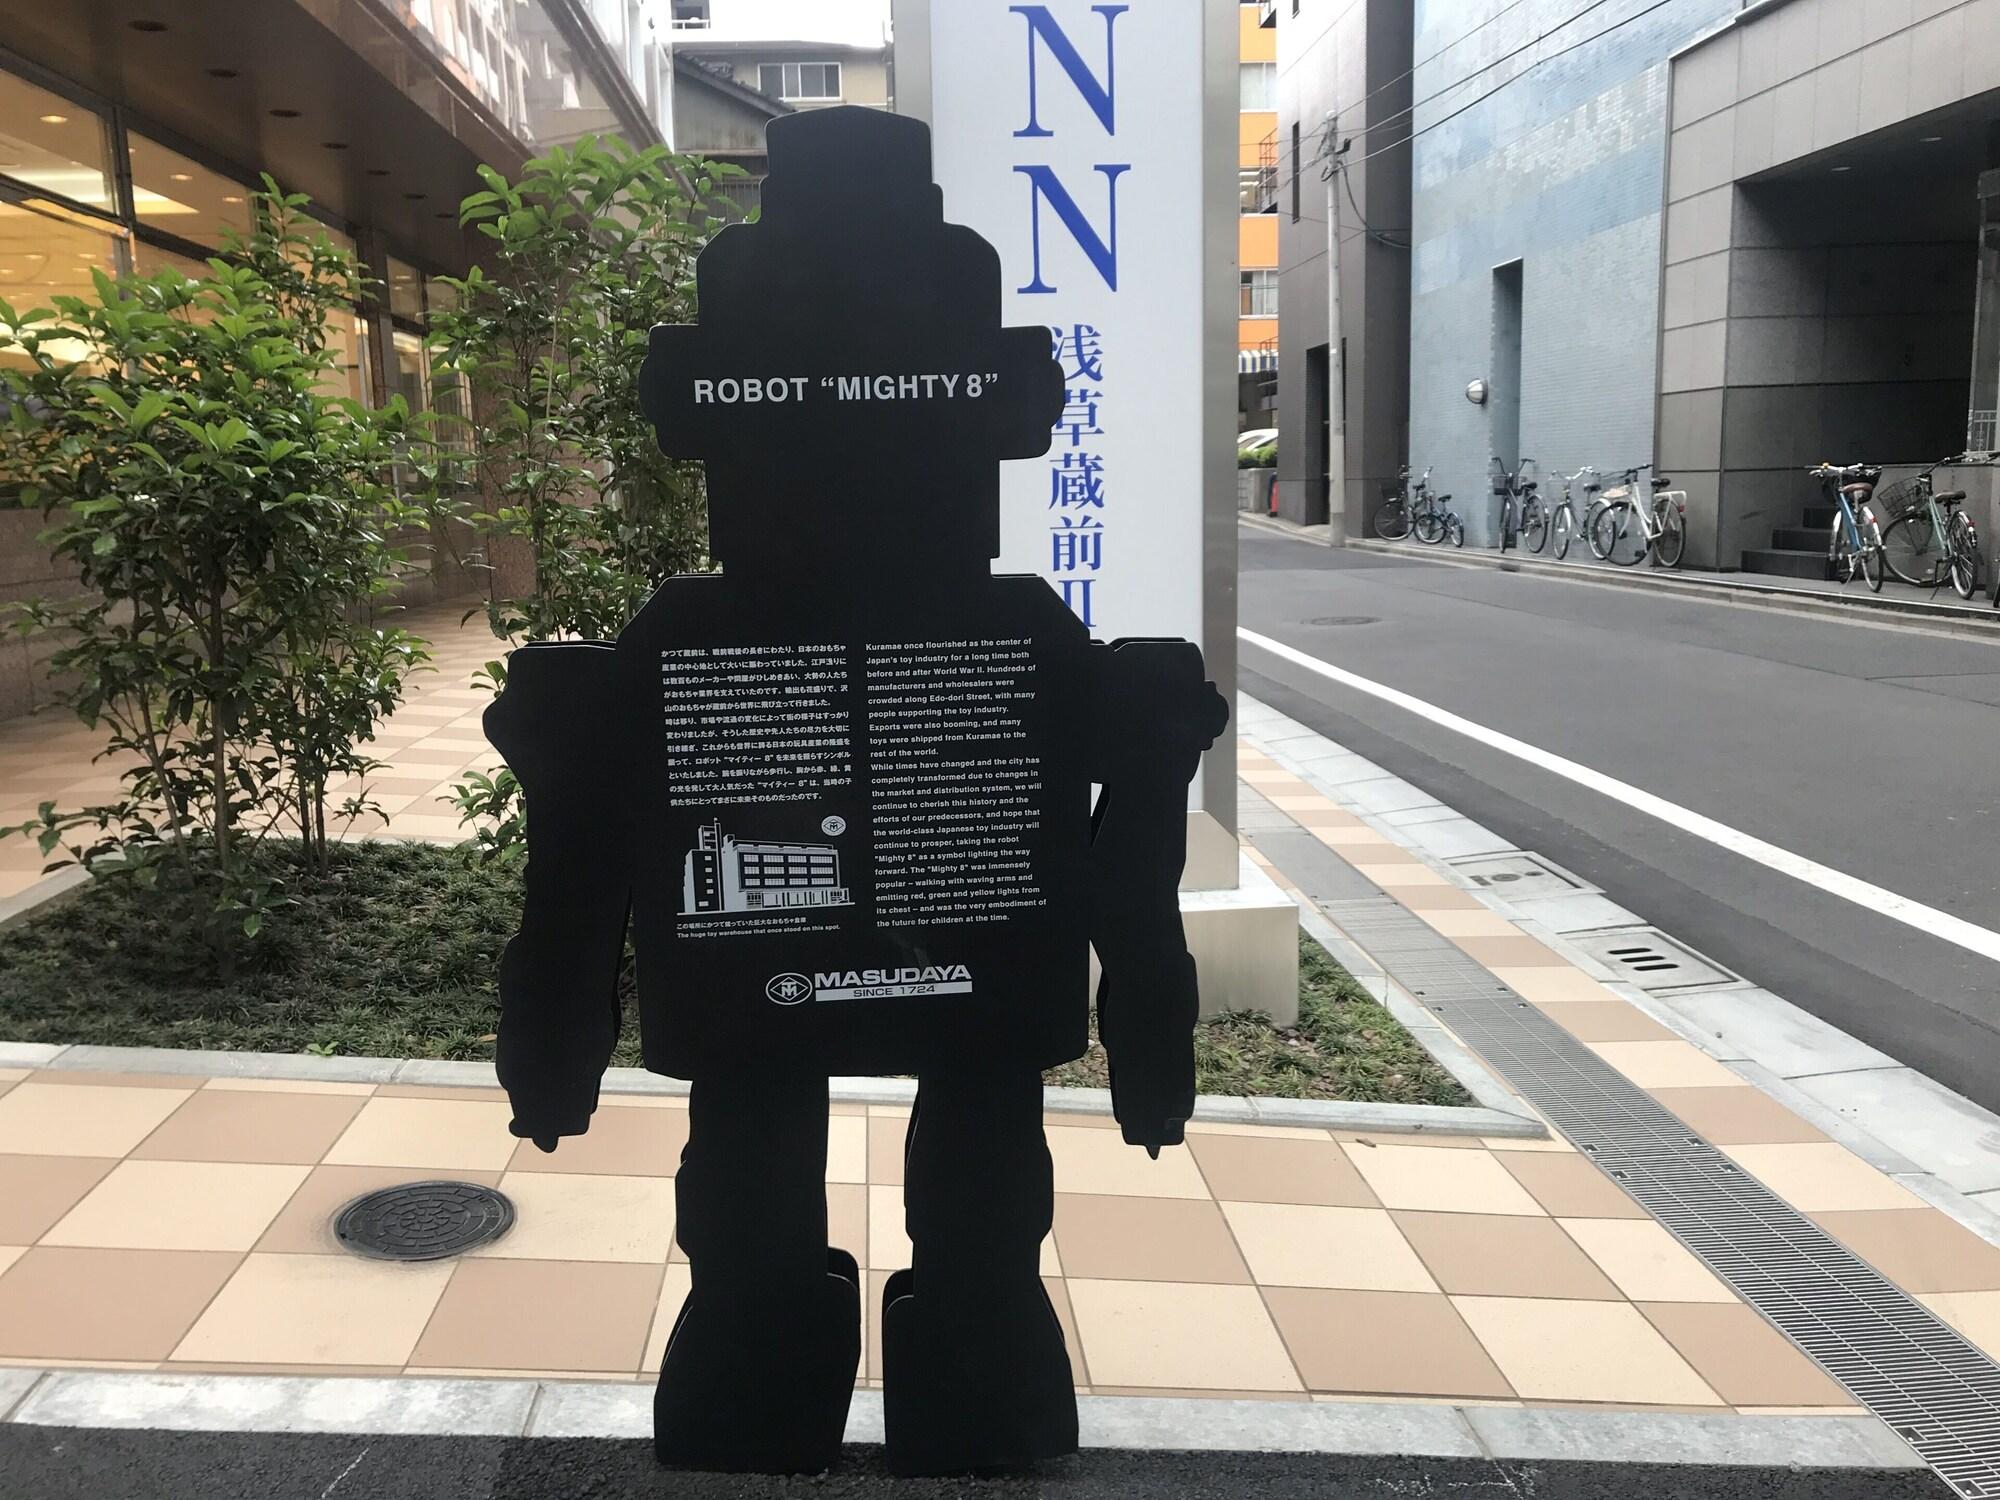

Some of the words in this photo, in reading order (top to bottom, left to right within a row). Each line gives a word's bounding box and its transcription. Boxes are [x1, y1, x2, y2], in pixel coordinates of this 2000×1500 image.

[694, 377, 809, 403] ROBOT
[821, 374, 960, 401] “MIGHTY
[925, 640, 966, 648] flourished
[866, 656, 897, 665] Japan's
[899, 656, 912, 664] toy
[971, 653, 989, 661] long
[986, 664, 1025, 672] Hundreds
[867, 696, 902, 704] crowded
[904, 695, 927, 703] along
[929, 693, 963, 701] Edo-dori
[994, 691, 1011, 699] with
[868, 710, 896, 719] people
[898, 708, 941, 717] supporting
[958, 707, 971, 715] toy
[869, 723, 900, 732] Exports
[943, 720, 980, 728] booming,
[869, 737, 887, 745] toys
[910, 734, 942, 743] shipped
[940, 759, 974, 768] changed
[1008, 757, 1023, 765] city
[871, 775, 915, 784] completely
[917, 773, 965, 781] transformed
[872, 802, 907, 810] continue
[969, 798, 997, 806] history
[999, 796, 1013, 804] and
[887, 827, 934, 835] world-class
[936, 826, 974, 834] Japanese
[937, 851, 965, 860] symbol
[967, 849, 998, 858] lighting
[874, 867, 908, 875] forward.
[988, 861, 1030, 869] immensely
[875, 880, 906, 889] popular
[914, 878, 945, 886] walking
[875, 893, 908, 901] emitting
[928, 892, 950, 900] green
[952, 889, 967, 897] and
[969, 889, 995, 897] yellow
[997, 887, 1019, 896] lights
[988, 899, 1036, 908] embodiment
[931, 916, 963, 924] children
[814, 964, 972, 988] MASUDAYA
[853, 988, 894, 998] SINCE
[900, 985, 936, 995] 1724
